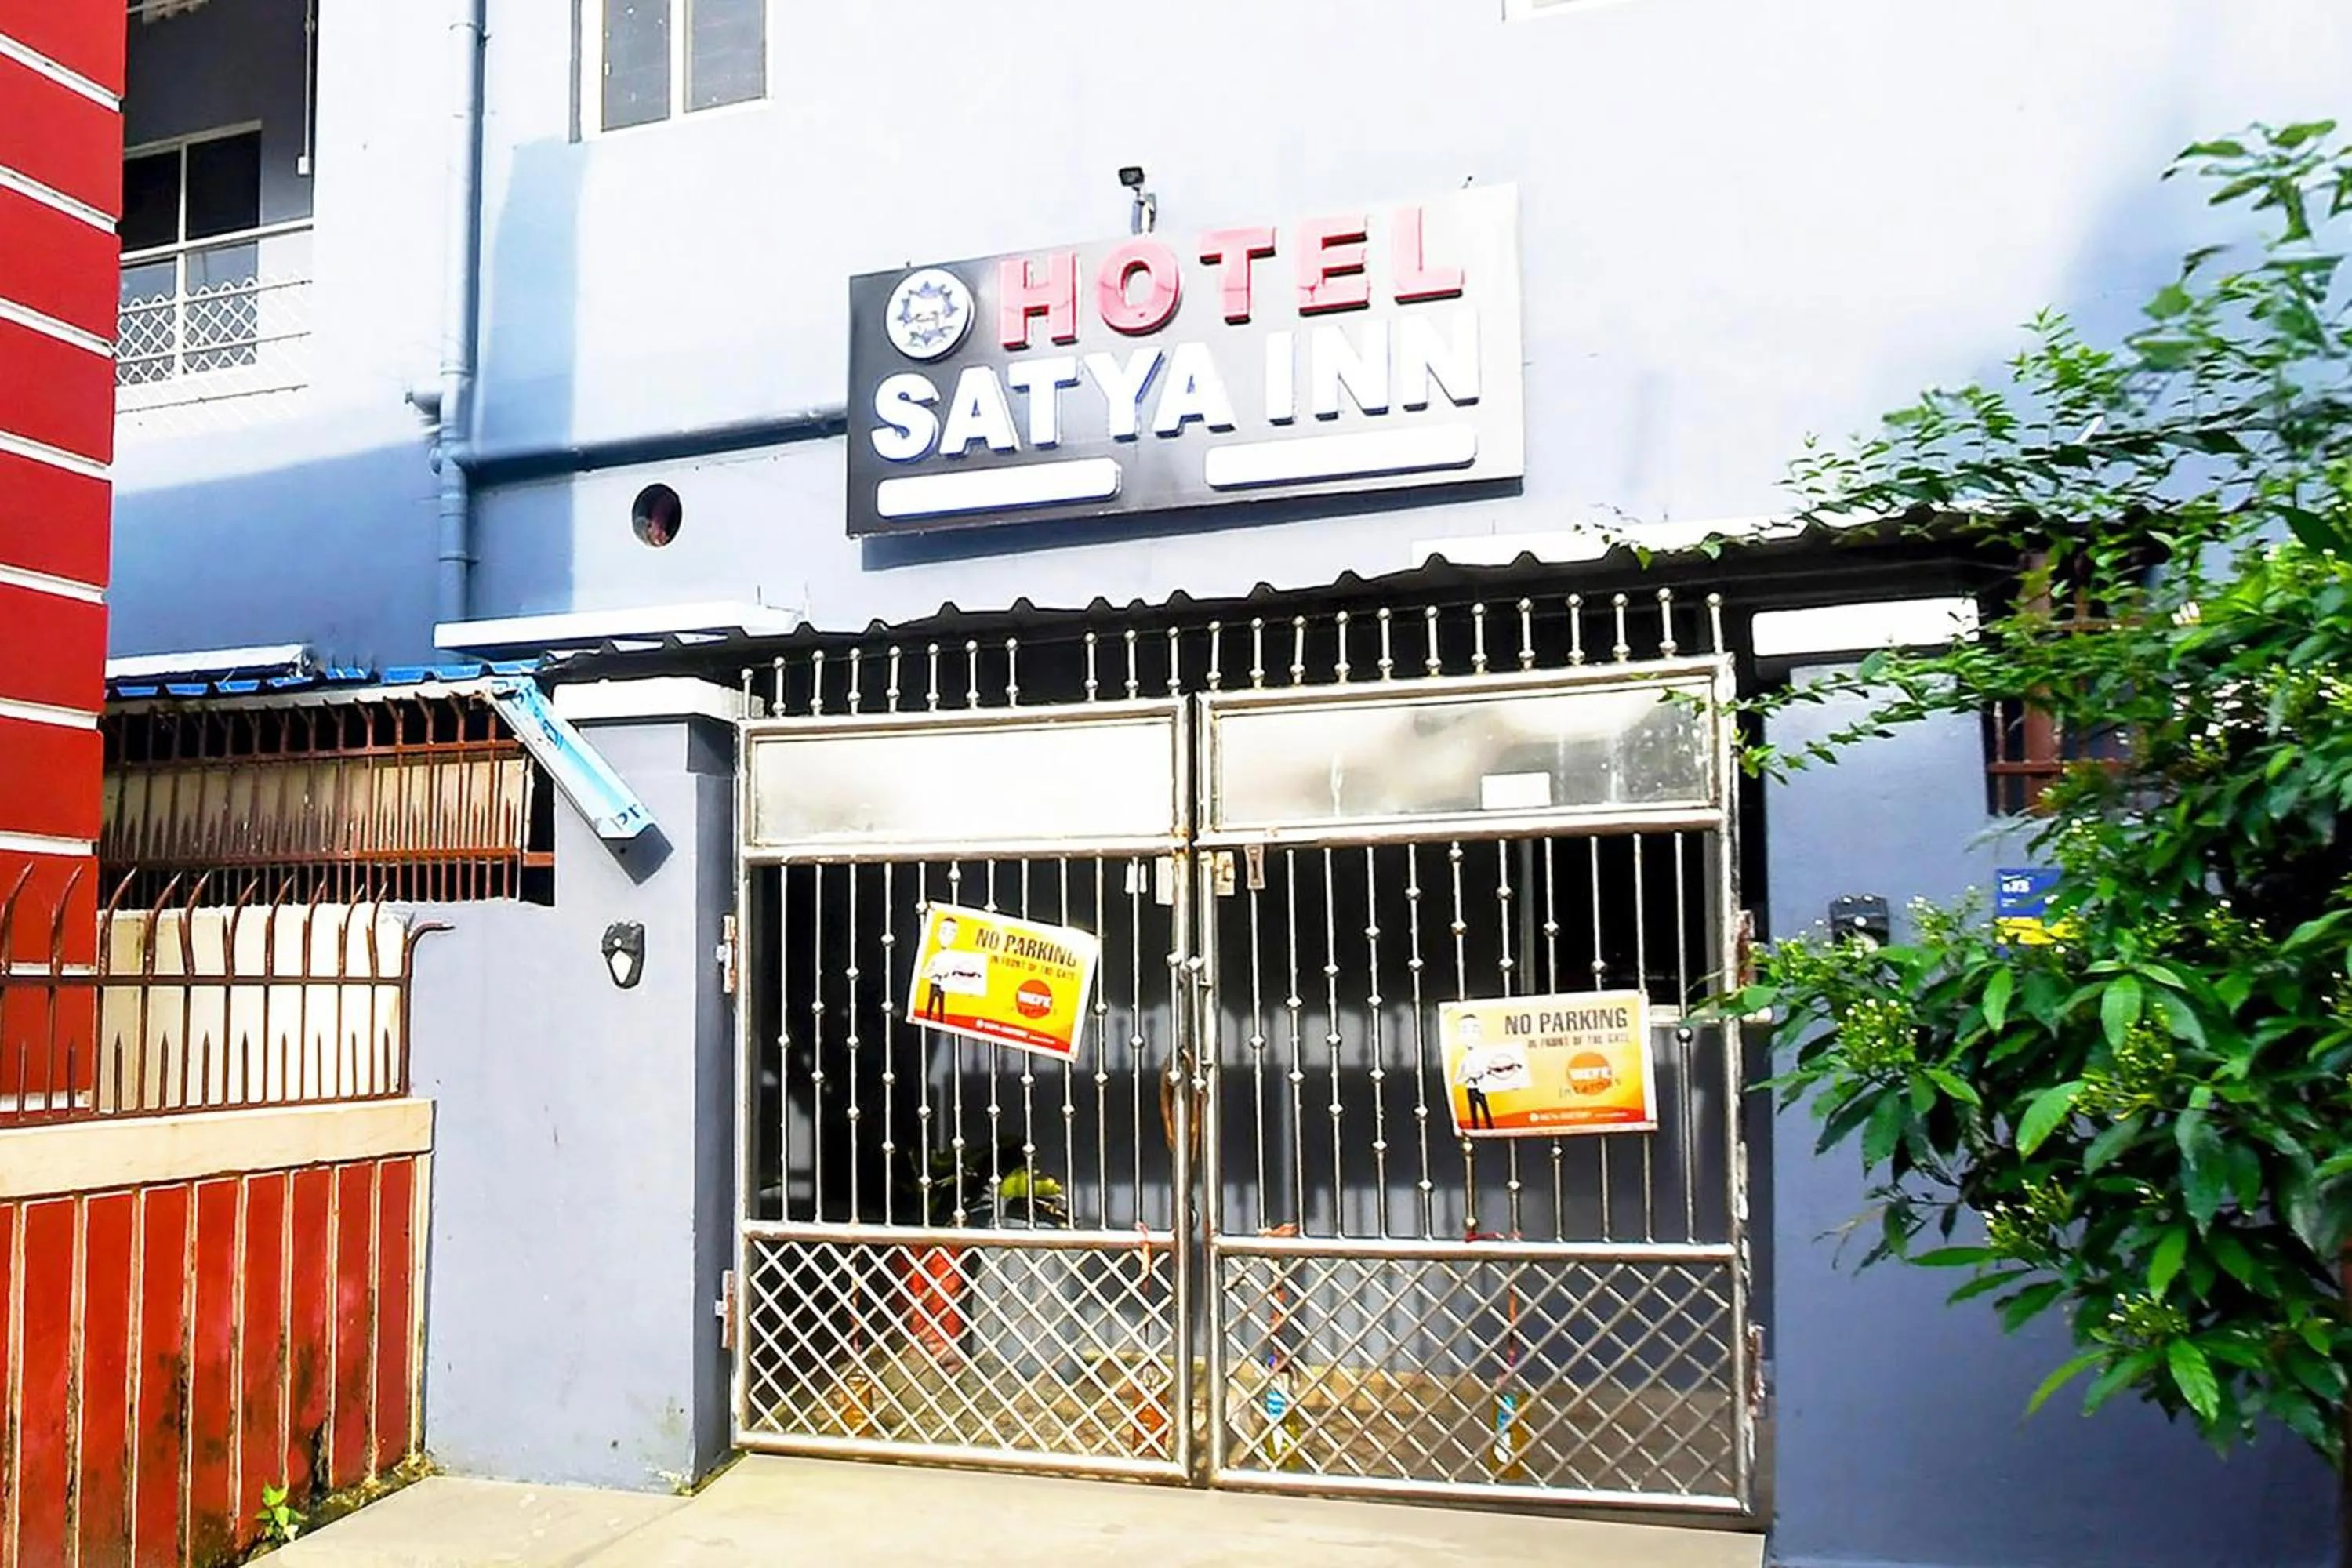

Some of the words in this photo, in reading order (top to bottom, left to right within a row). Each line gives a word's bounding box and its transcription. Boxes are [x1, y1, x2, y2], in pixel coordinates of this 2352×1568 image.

[999, 206, 1465, 350] HOTEL
[872, 342, 1236, 461] SATYA
[1265, 309, 1480, 425] INN
[976, 928, 1000, 949] NO
[1004, 934, 1076, 967] PARKING
[1504, 1014, 1531, 1036] NO
[1540, 1007, 1628, 1033] PARKING
